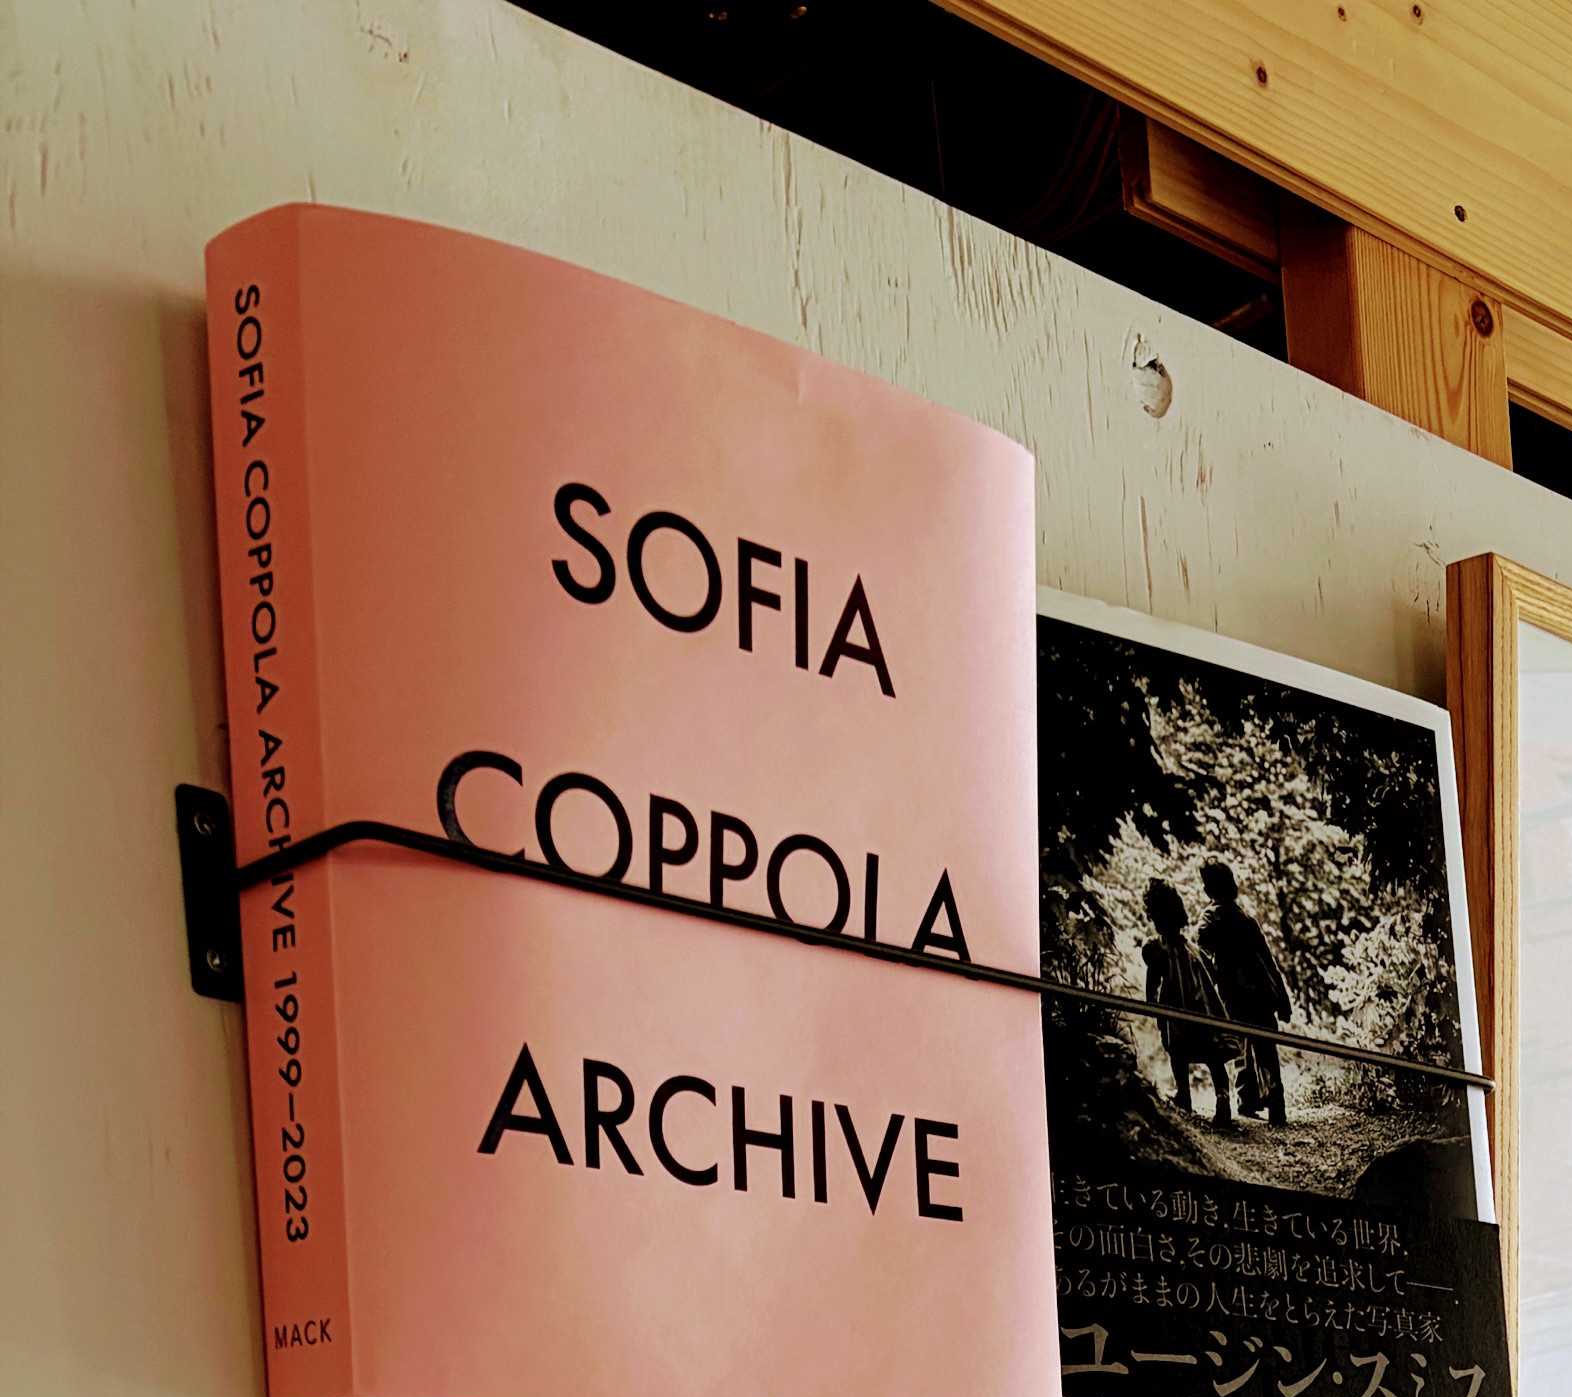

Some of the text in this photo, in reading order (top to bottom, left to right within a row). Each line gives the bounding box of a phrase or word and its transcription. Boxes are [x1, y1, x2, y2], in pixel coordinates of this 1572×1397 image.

[234, 283, 267, 448] SOFIA
[242, 460, 281, 715] COPPOLA
[550, 482, 897, 699] SOFIA
[256, 727, 297, 953] ARCHIVE
[436, 749, 973, 965] COPPOLA
[477, 1042, 964, 1223] ARCHIVE
[274, 1318, 333, 1351] MACK
